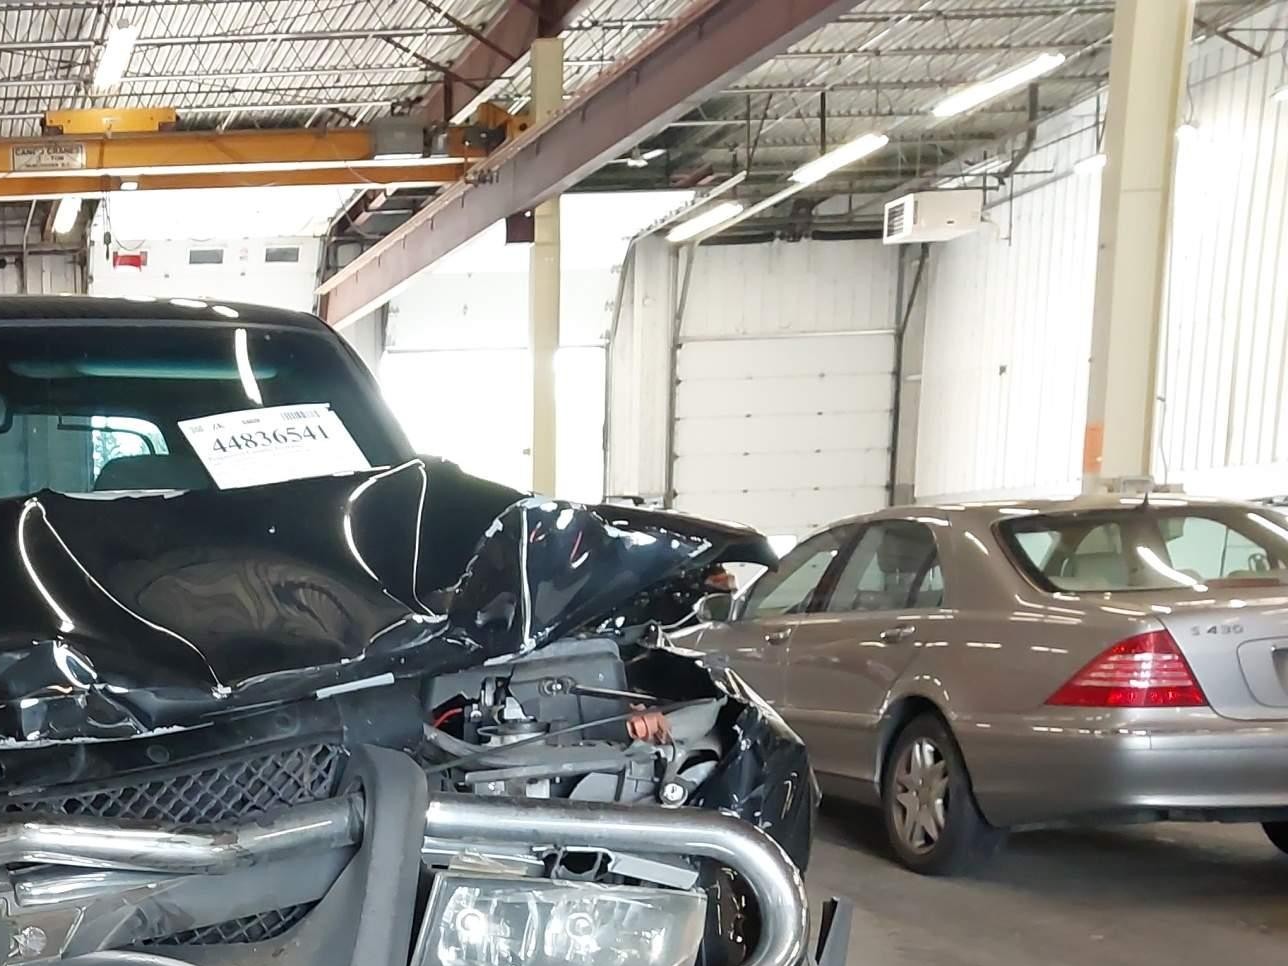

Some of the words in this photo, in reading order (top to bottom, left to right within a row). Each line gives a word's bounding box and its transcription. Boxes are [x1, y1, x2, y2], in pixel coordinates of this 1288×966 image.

[212, 424, 330, 453] 44836541
[1190, 625, 1201, 637] S
[1206, 624, 1244, 635] 430
